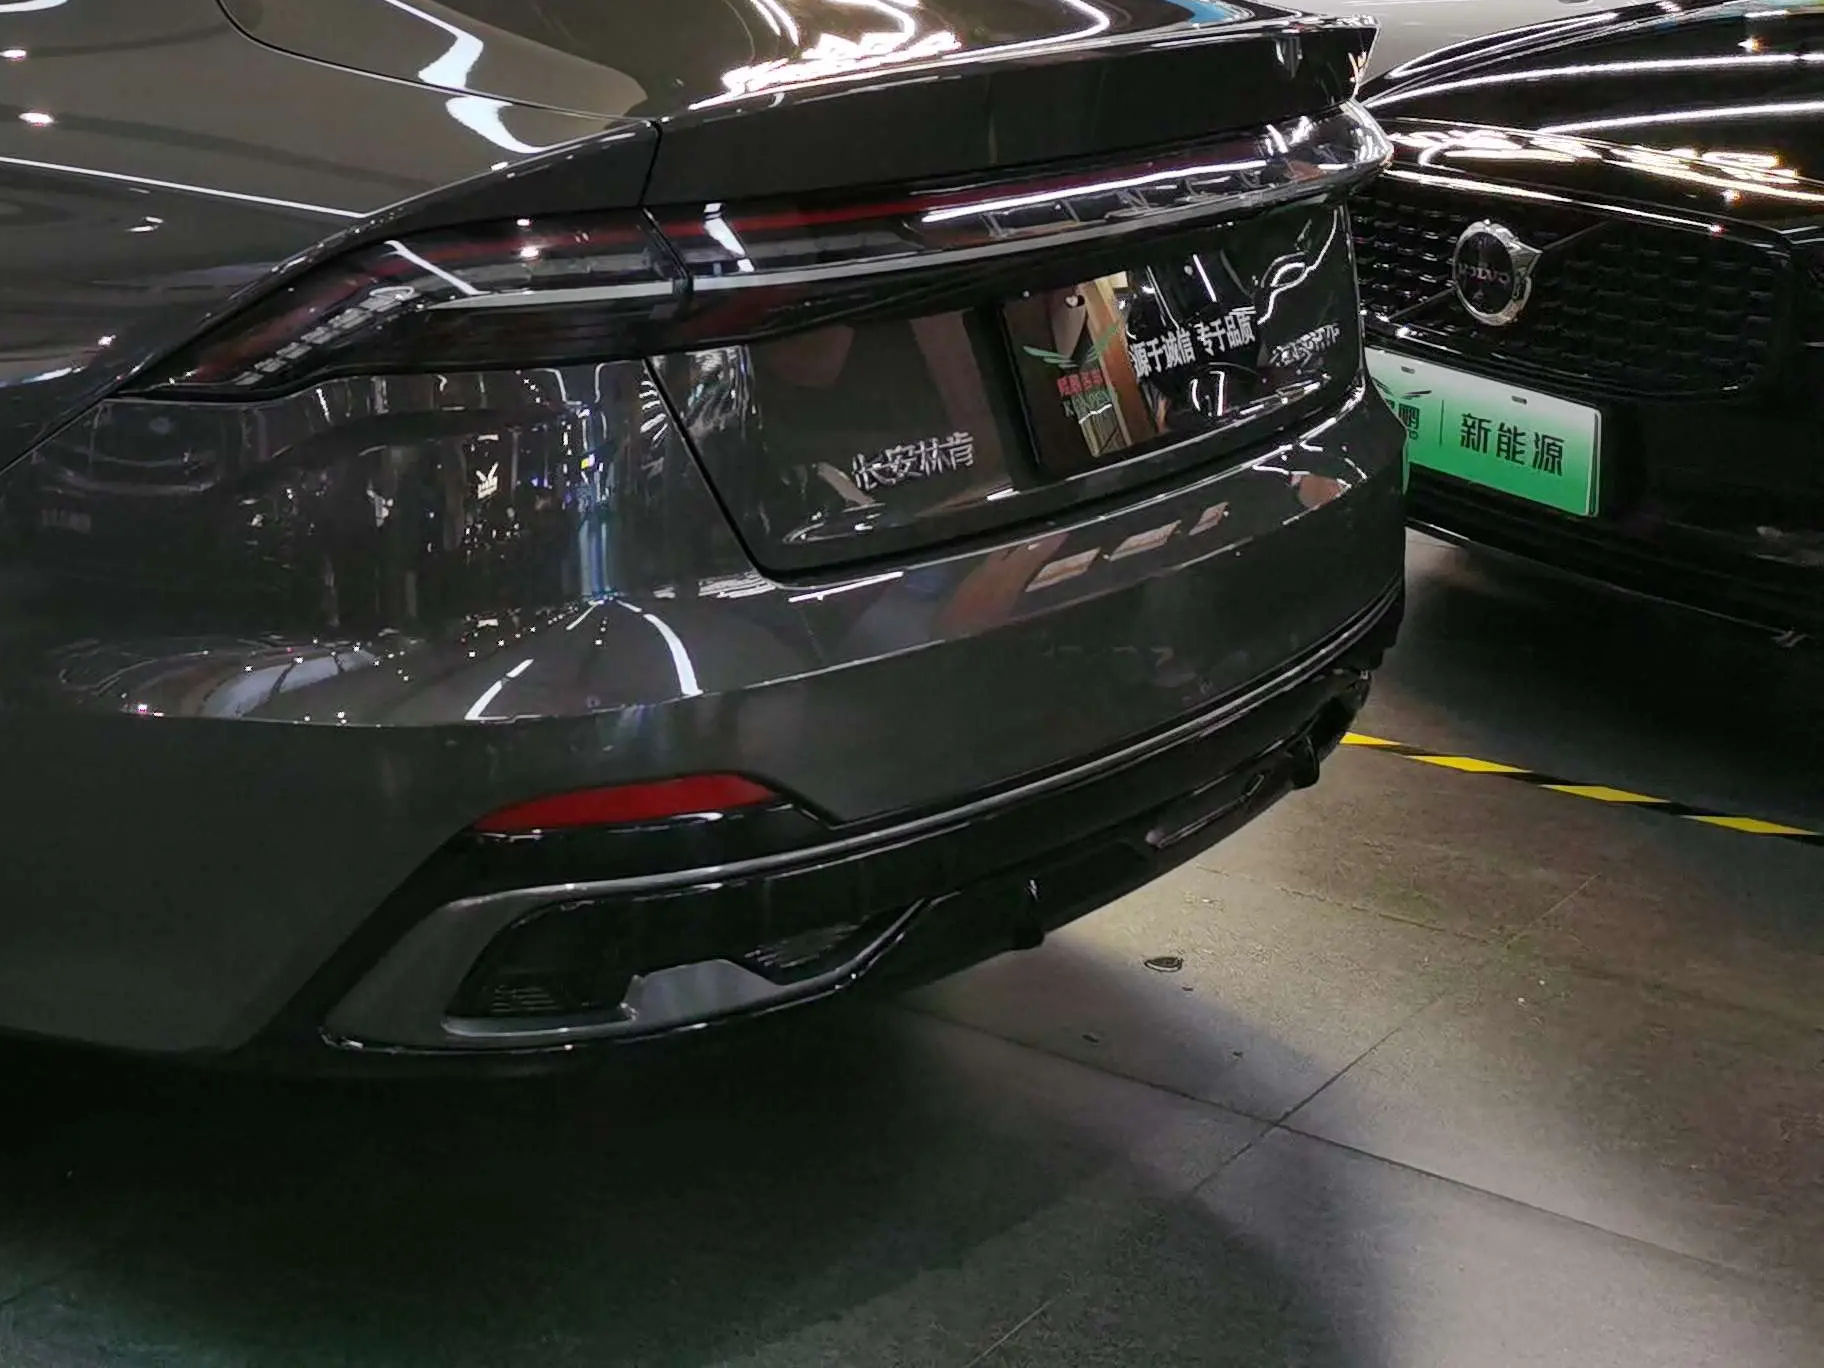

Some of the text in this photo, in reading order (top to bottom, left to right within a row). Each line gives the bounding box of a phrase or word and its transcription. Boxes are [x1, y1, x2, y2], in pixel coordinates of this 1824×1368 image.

[851, 431, 975, 491] 长安林肯
[1460, 412, 1566, 477] 新能源
